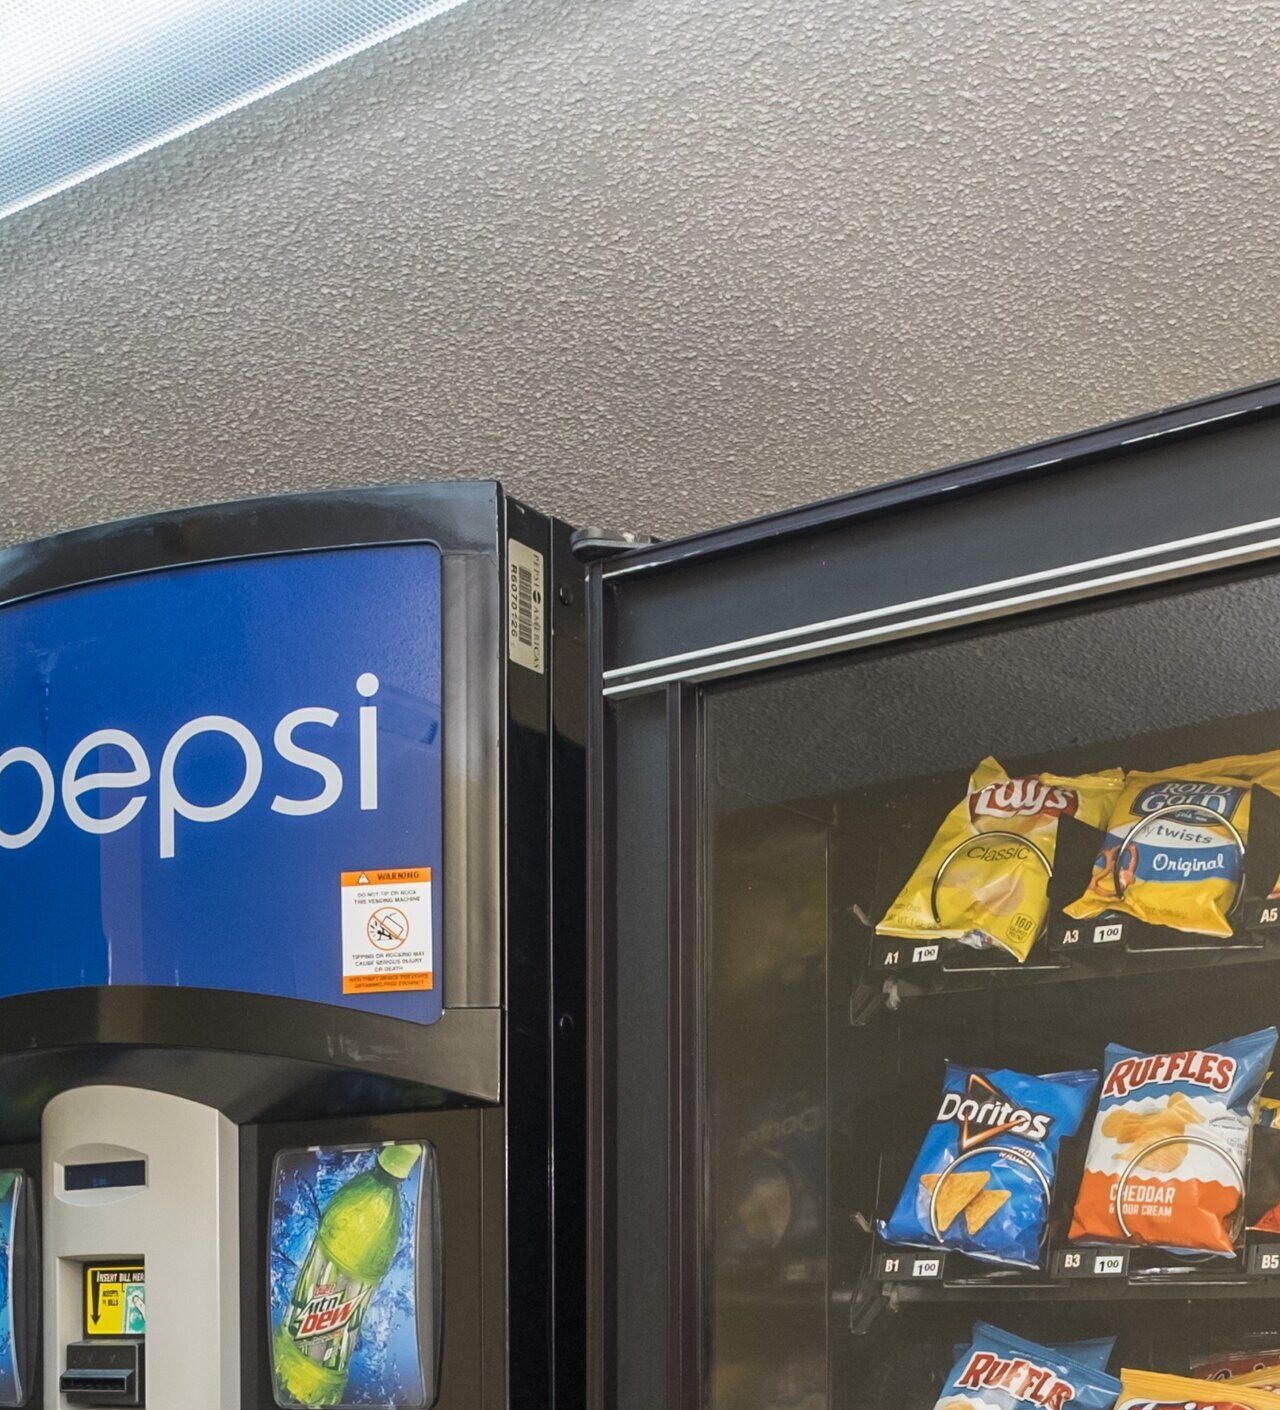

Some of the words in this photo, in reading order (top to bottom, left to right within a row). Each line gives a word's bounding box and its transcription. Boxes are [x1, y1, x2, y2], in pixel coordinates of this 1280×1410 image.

[1140, 793, 1227, 817] GOLD
[1156, 824, 1213, 845] twists
[966, 843, 1031, 862] Classic
[1152, 852, 1226, 878] Original
[376, 871, 420, 881] WARNING
[1259, 908, 1279, 923] A5
[1062, 929, 1080, 944] A3
[883, 951, 900, 965] A1
[1102, 1051, 1236, 1097] RUFFLES
[936, 1093, 1051, 1140] Doritos
[1109, 1184, 1176, 1204] CHEDDAR
[1141, 1204, 1173, 1217] CREAM
[884, 1258, 900, 1273] B1
[1064, 1254, 1081, 1269] B3
[1261, 1254, 1280, 1270] B5
[132, 1271, 145, 1283] HER
